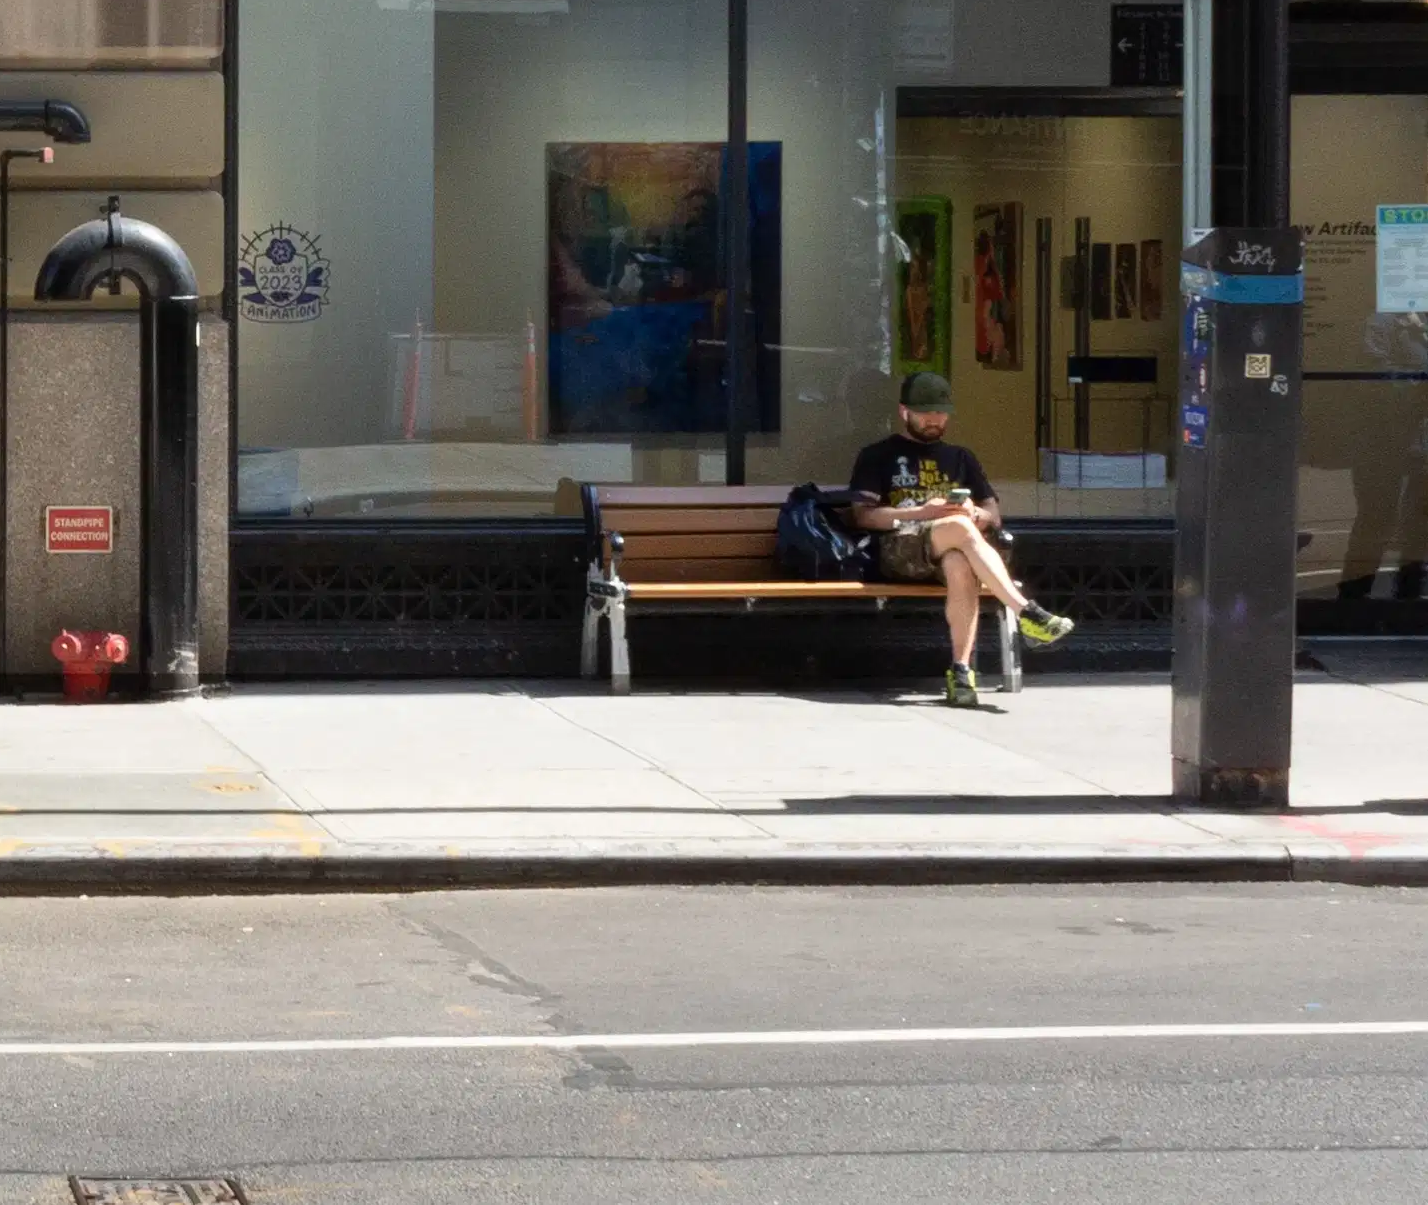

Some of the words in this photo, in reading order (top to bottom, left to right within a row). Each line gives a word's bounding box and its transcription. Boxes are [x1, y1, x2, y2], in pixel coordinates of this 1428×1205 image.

[1384, 210, 1428, 223] STO
[258, 266, 288, 275] CLASS
[290, 266, 304, 275] OF
[260, 276, 303, 291] 2023
[54, 518, 104, 528] STANDPIPE
[50, 531, 108, 541] CONNECTION
